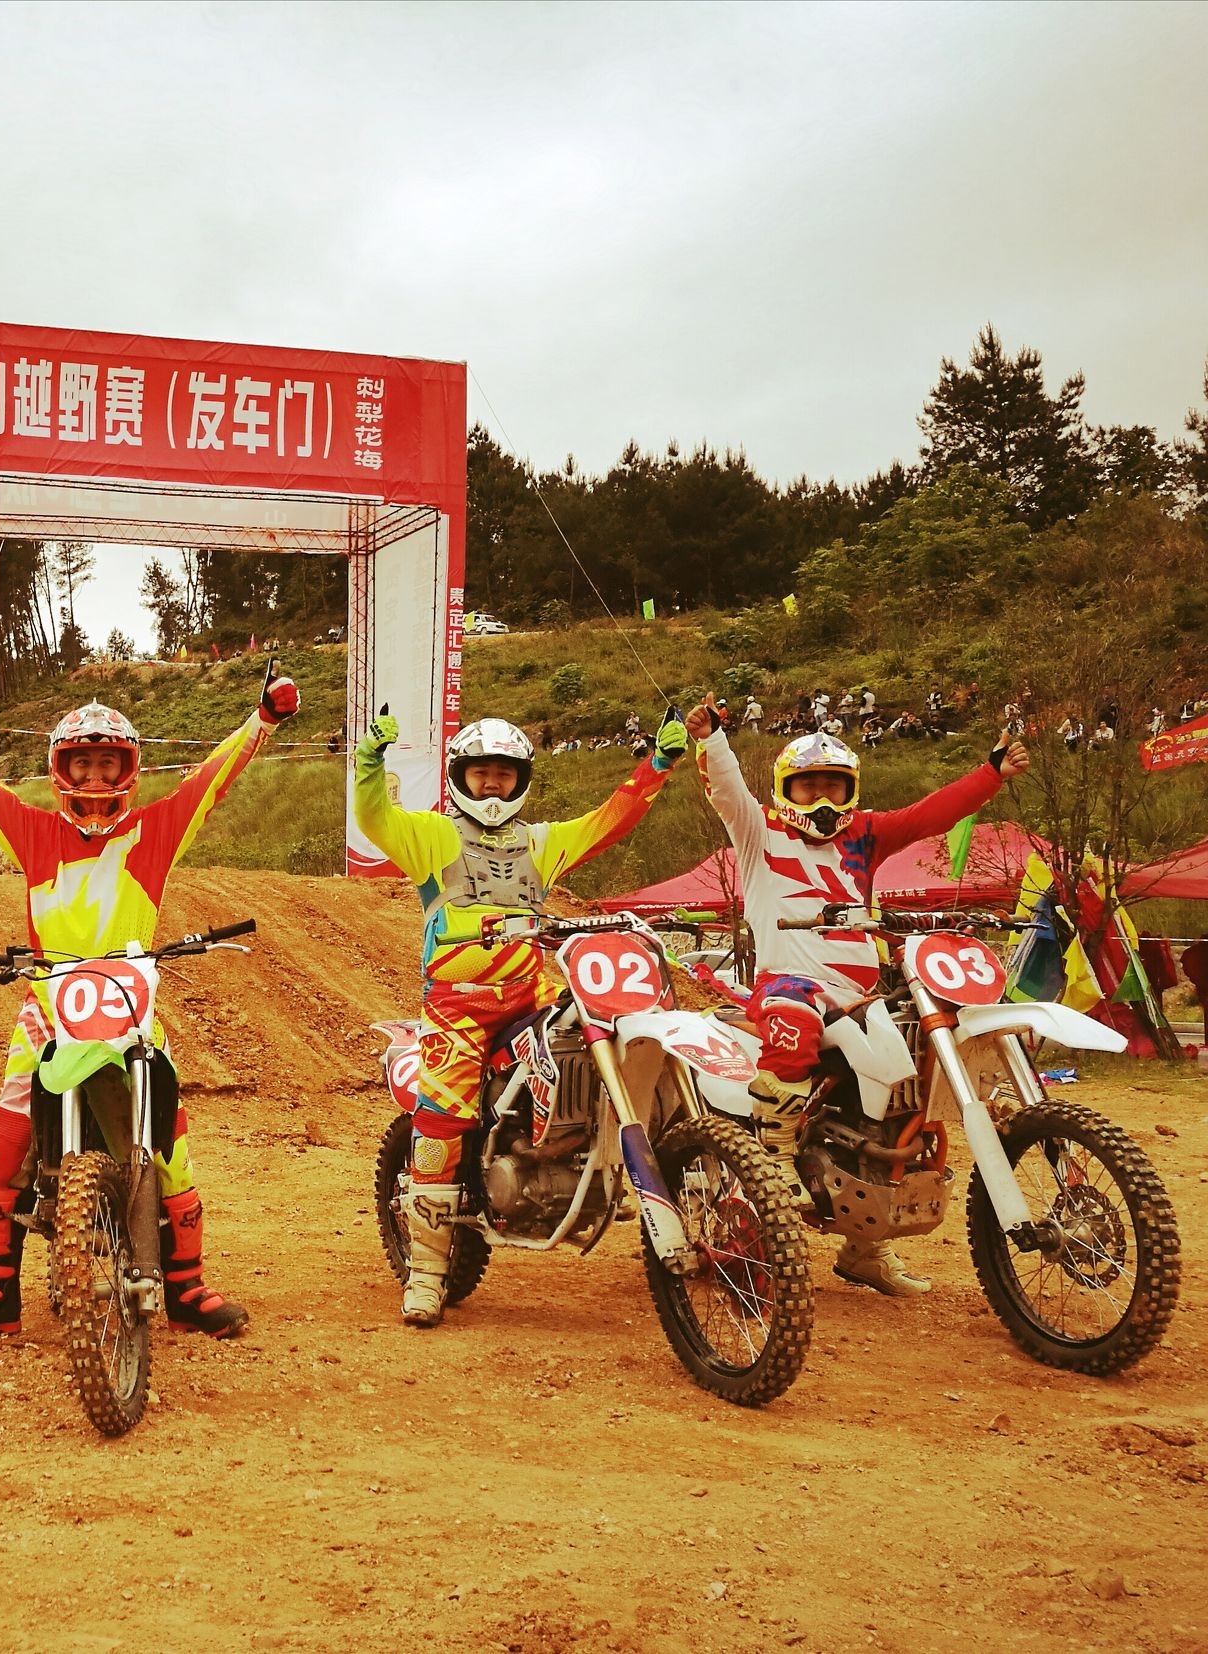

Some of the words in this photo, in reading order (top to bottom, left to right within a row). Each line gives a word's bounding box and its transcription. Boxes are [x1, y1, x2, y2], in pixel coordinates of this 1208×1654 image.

[354, 376, 384, 470] 刺梨花海
[558, 914, 632, 929] RENTHAL
[577, 951, 656, 996] 02
[925, 946, 996, 989] 03
[63, 975, 138, 1023] 05
[644, 1207, 660, 1238] SPORTS
